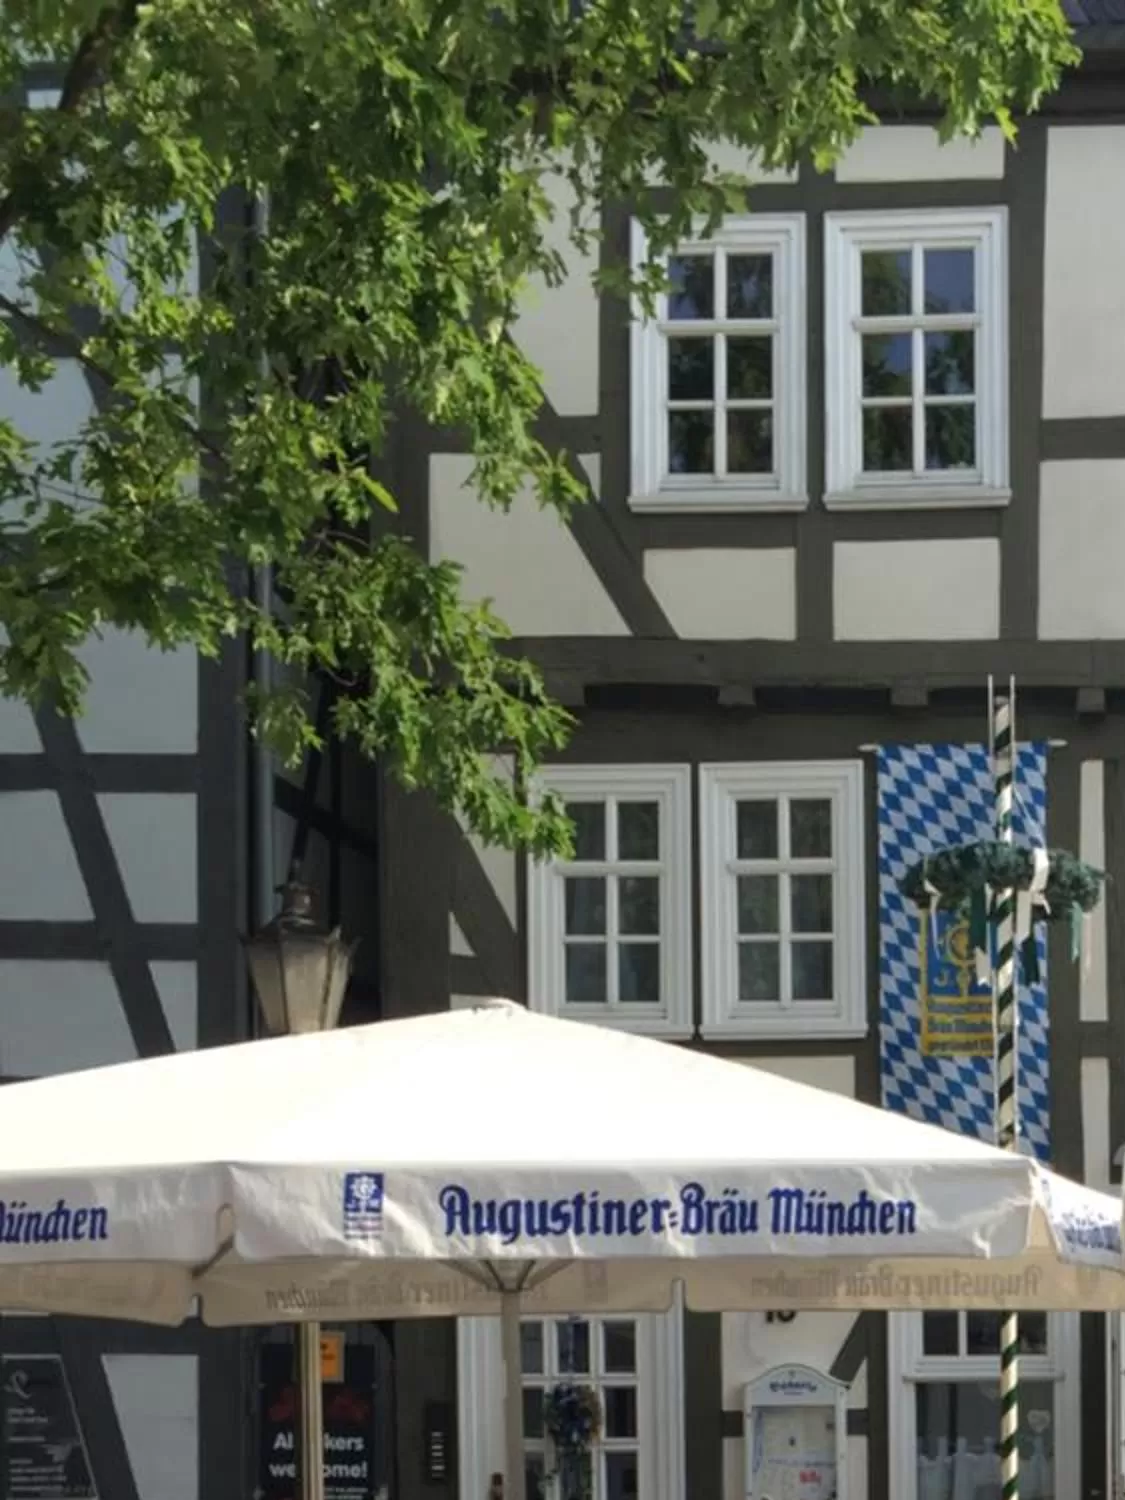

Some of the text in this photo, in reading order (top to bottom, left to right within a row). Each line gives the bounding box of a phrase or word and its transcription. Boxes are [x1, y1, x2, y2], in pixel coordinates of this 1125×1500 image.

[0, 1199, 108, 1244] ünchen
[768, 1187, 917, 1236] München
[272, 1431, 294, 1450] Al
[268, 1460, 368, 1478] weome!
